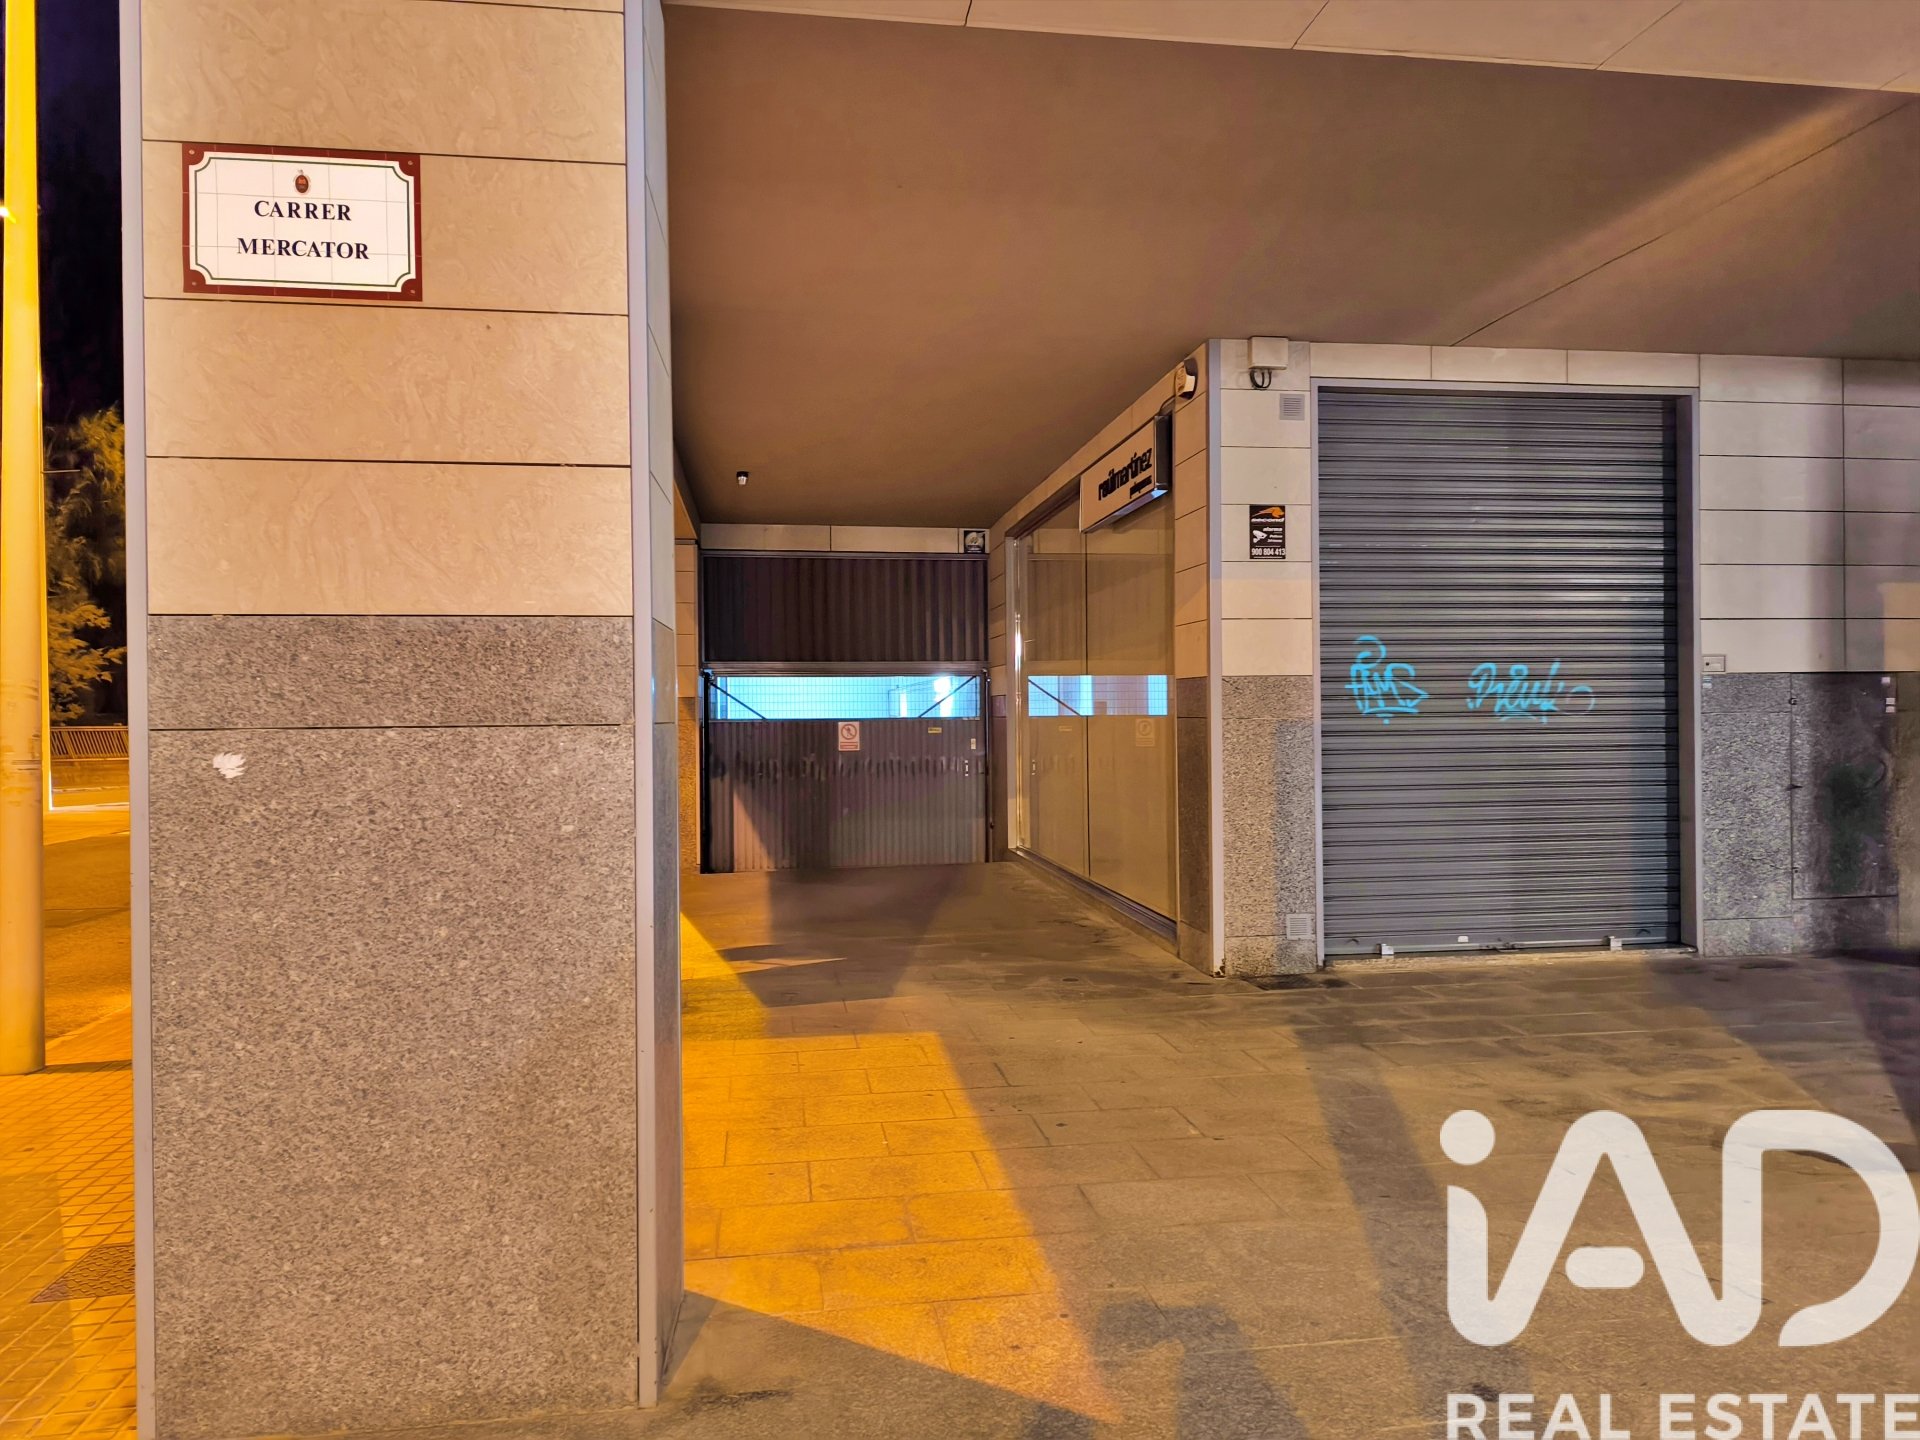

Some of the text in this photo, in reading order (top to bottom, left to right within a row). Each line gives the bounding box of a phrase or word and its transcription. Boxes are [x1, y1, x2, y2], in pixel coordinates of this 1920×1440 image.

[254, 200, 352, 221] CARRER
[237, 238, 370, 260] MERCATOR
[1251, 548, 1263, 556] 900
[1275, 548, 1286, 556] 413
